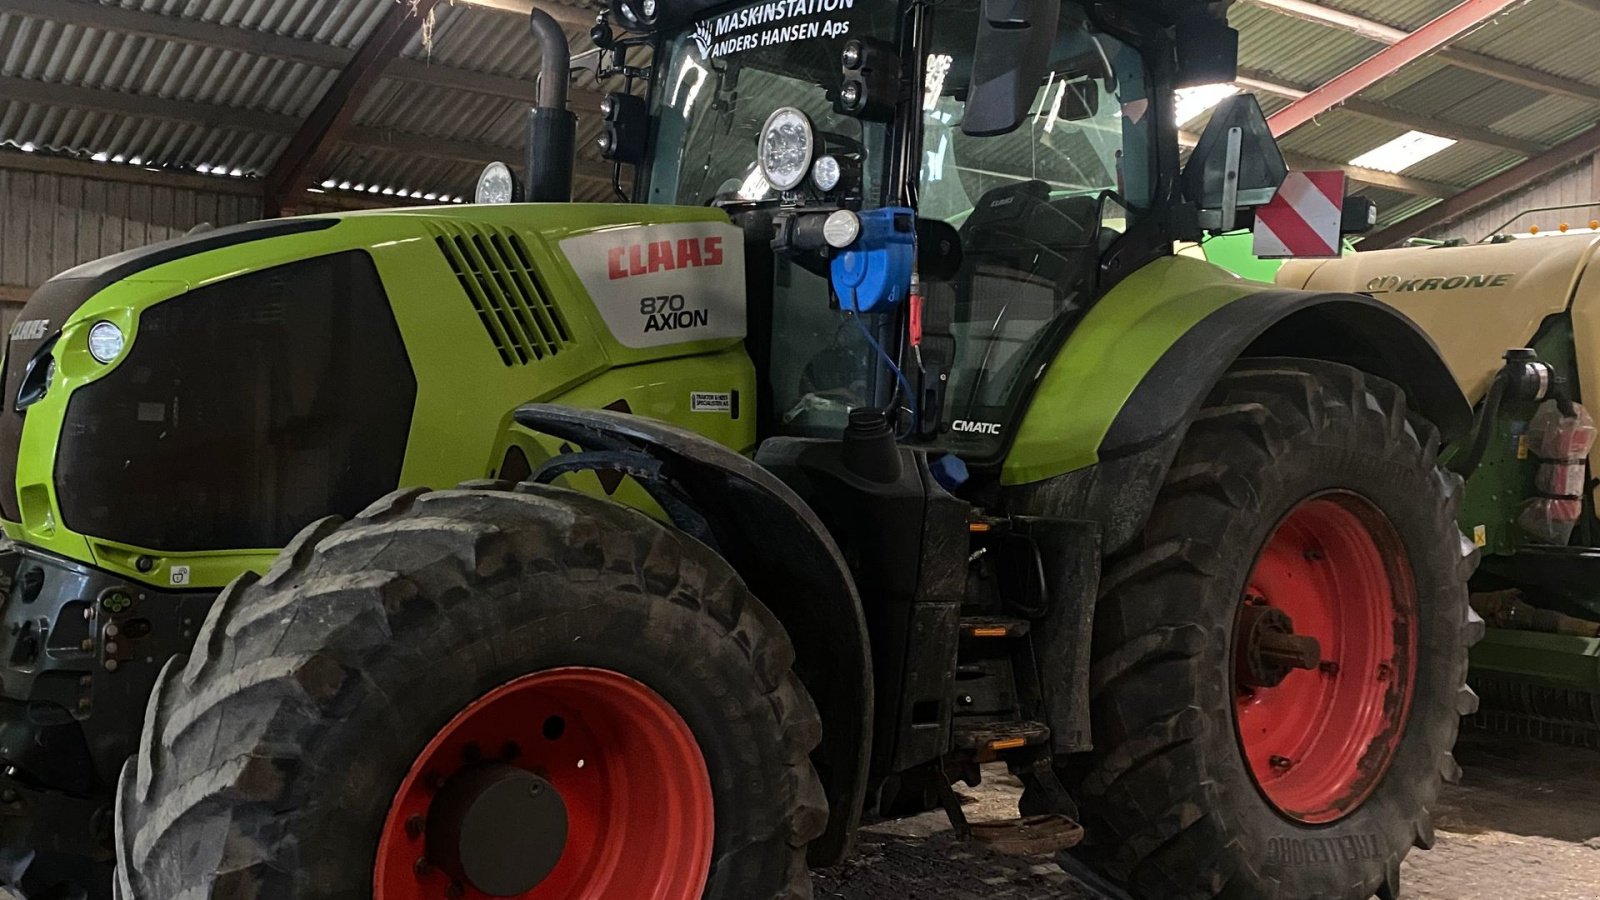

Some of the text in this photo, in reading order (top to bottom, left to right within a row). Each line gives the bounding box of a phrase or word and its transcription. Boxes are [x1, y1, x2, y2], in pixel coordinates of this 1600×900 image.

[711, 19, 850, 58] ANDERS HANSEN Aps
[608, 236, 723, 280] CLAAS
[1395, 273, 1516, 292] KRONE
[640, 294, 684, 315] 870
[644, 309, 708, 333] AXION
[952, 420, 1001, 434] CMATIC
[1267, 834, 1384, 867] TRELLEBORG
